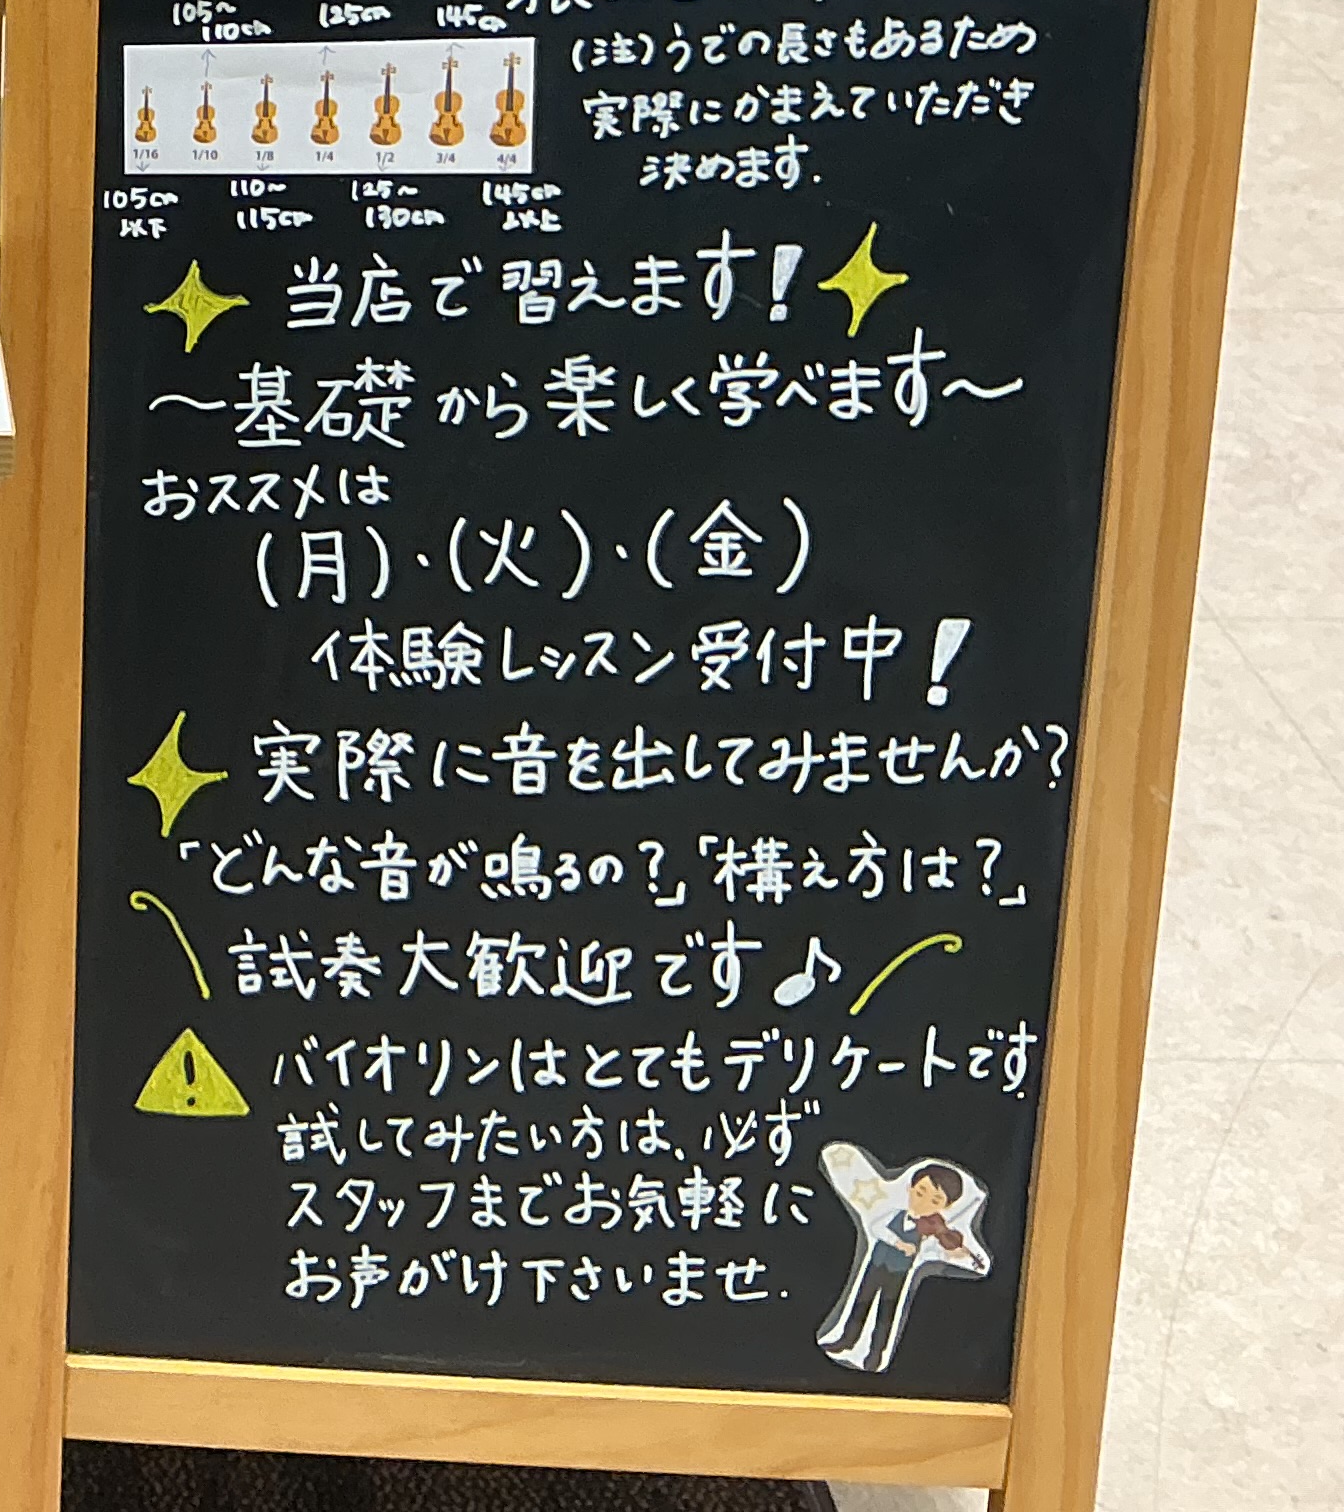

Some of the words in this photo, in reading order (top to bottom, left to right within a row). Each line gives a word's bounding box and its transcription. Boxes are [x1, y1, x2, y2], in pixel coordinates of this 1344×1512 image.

[583, 78, 1036, 141] 実際にかまえていただき
[132, 148, 159, 161] 1/16
[192, 148, 218, 161] 1/10
[283, 227, 803, 330] 当店で習えます!
[140, 463, 392, 522] おススメは
[309, 612, 972, 707] 体験レッスン受付中!
[252, 720, 1068, 808] 実際に音を出してみませんか?
[273, 1020, 1038, 1100] バイオリンはとてもデリケートです
[285, 1171, 812, 1234] スタッフまでお気軽に
